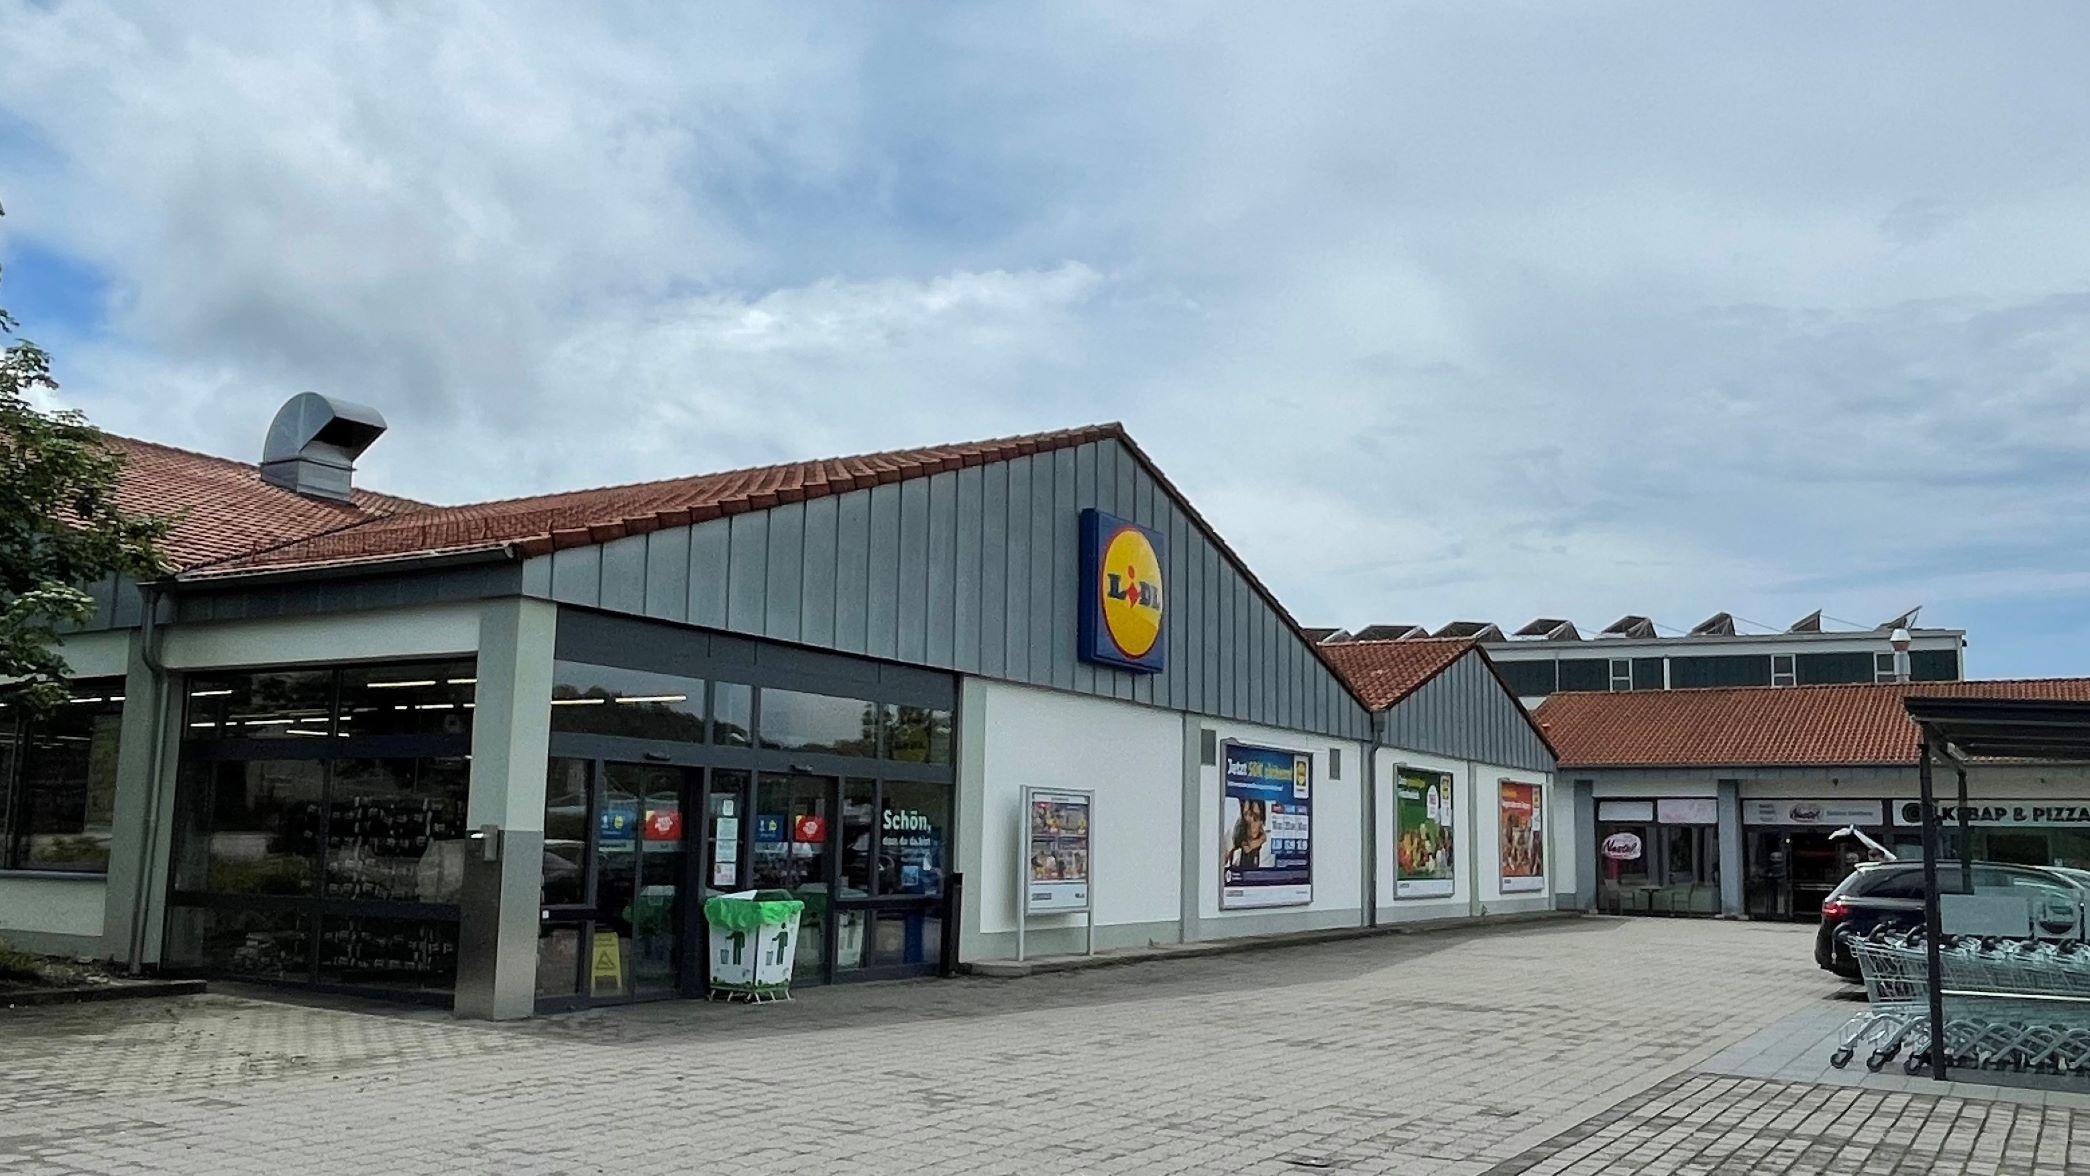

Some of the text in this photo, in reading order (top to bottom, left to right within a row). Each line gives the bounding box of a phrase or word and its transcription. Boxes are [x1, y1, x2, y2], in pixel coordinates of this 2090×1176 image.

[883, 809, 931, 833] Schön,
[1942, 807, 2090, 822] KBAP & PIZZA
